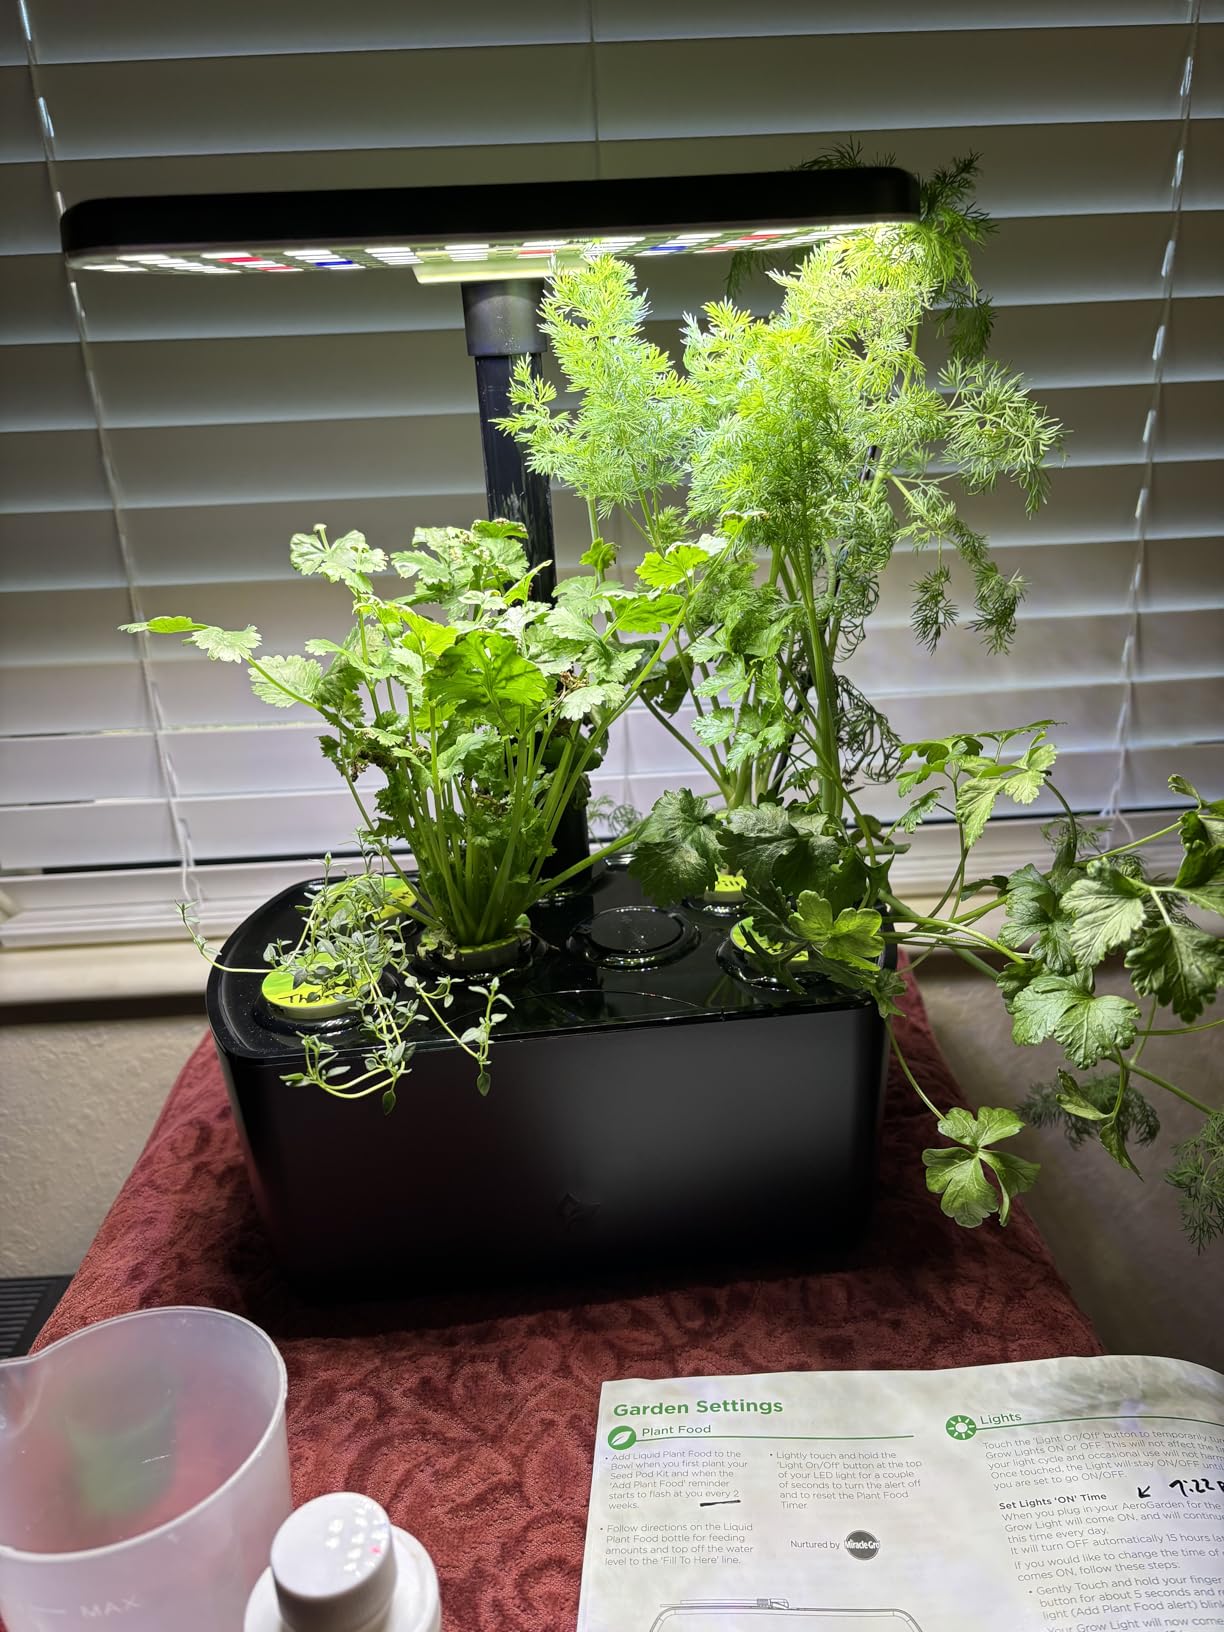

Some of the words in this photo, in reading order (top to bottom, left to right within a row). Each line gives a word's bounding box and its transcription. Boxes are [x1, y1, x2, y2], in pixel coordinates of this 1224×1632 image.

[614, 1403, 688, 1416] Garden
[696, 1399, 783, 1414] Settings
[980, 1413, 1021, 1425] Lights
[642, 1426, 674, 1437] Plant
[678, 1425, 711, 1434] Food
[983, 1440, 1012, 1449] Touch
[1015, 1438, 1030, 1446] the
[1153, 1431, 1207, 1441] temporarily
[633, 1452, 660, 1460] Liquid
[777, 1452, 807, 1460] Lightly
[662, 1461, 679, 1469] you
[702, 1460, 725, 1468] plant
[728, 1461, 747, 1469] your
[991, 1471, 1017, 1479] Once
[1020, 1466, 1064, 1476] touched,
[1066, 1463, 1082, 1471] the
[1086, 1462, 1111, 1470] Light
[611, 1472, 632, 1480] Seed
[778, 1471, 789, 1479] of
[791, 1472, 810, 1480] your
[836, 1472, 856, 1480] light
[883, 1471, 914, 1479] couple
[866, 1481, 882, 1489] the
[993, 1481, 1012, 1490] you
[1034, 1476, 1049, 1485] set
[1065, 1475, 1078, 1483] go
[780, 1491, 798, 1499] and
[999, 1502, 1017, 1510] Set
[1020, 1498, 1052, 1508] Lights
[1080, 1493, 1107, 1501] Time
[1002, 1511, 1033, 1521] When
[1036, 1510, 1054, 1519] you
[1057, 1507, 1080, 1516] plug
[1094, 1504, 1118, 1514] your
[1123, 1501, 1184, 1510] AeroGarden
[1187, 1500, 1201, 1508] for
[1204, 1501, 1221, 1510] the
[607, 1524, 638, 1532] Follow
[723, 1523, 753, 1532] Liquid
[662, 1534, 690, 1542] bottle
[709, 1534, 745, 1543] feeding
[1007, 1535, 1027, 1544] this
[1030, 1533, 1053, 1541] time
[1056, 1529, 1084, 1537] every
[1088, 1527, 1108, 1535] day.
[672, 1545, 688, 1554] top
[708, 1545, 723, 1553] the
[790, 1540, 827, 1549] Nurtured
[829, 1541, 840, 1549] by
[605, 1558, 626, 1566] level
[642, 1557, 658, 1565] the
[722, 1556, 741, 1564] line.
[1018, 1571, 1053, 1581] comes
[1079, 1565, 1112, 1574] follow
[1115, 1562, 1145, 1571] these
[1037, 1584, 1072, 1595] Gently
[1075, 1580, 1109, 1590] Touch
[1112, 1578, 1132, 1587] and
[1134, 1577, 1159, 1585] hold
[1162, 1577, 1187, 1586] your
[1190, 1575, 1221, 1585] finger
[80, 1595, 141, 1616] MAX
[1043, 1610, 1069, 1620] light
[1071, 1606, 1099, 1617] (Add
[1102, 1604, 1131, 1613] Plant
[1134, 1601, 1164, 1611] Food
[1167, 1600, 1197, 1609] alert)
